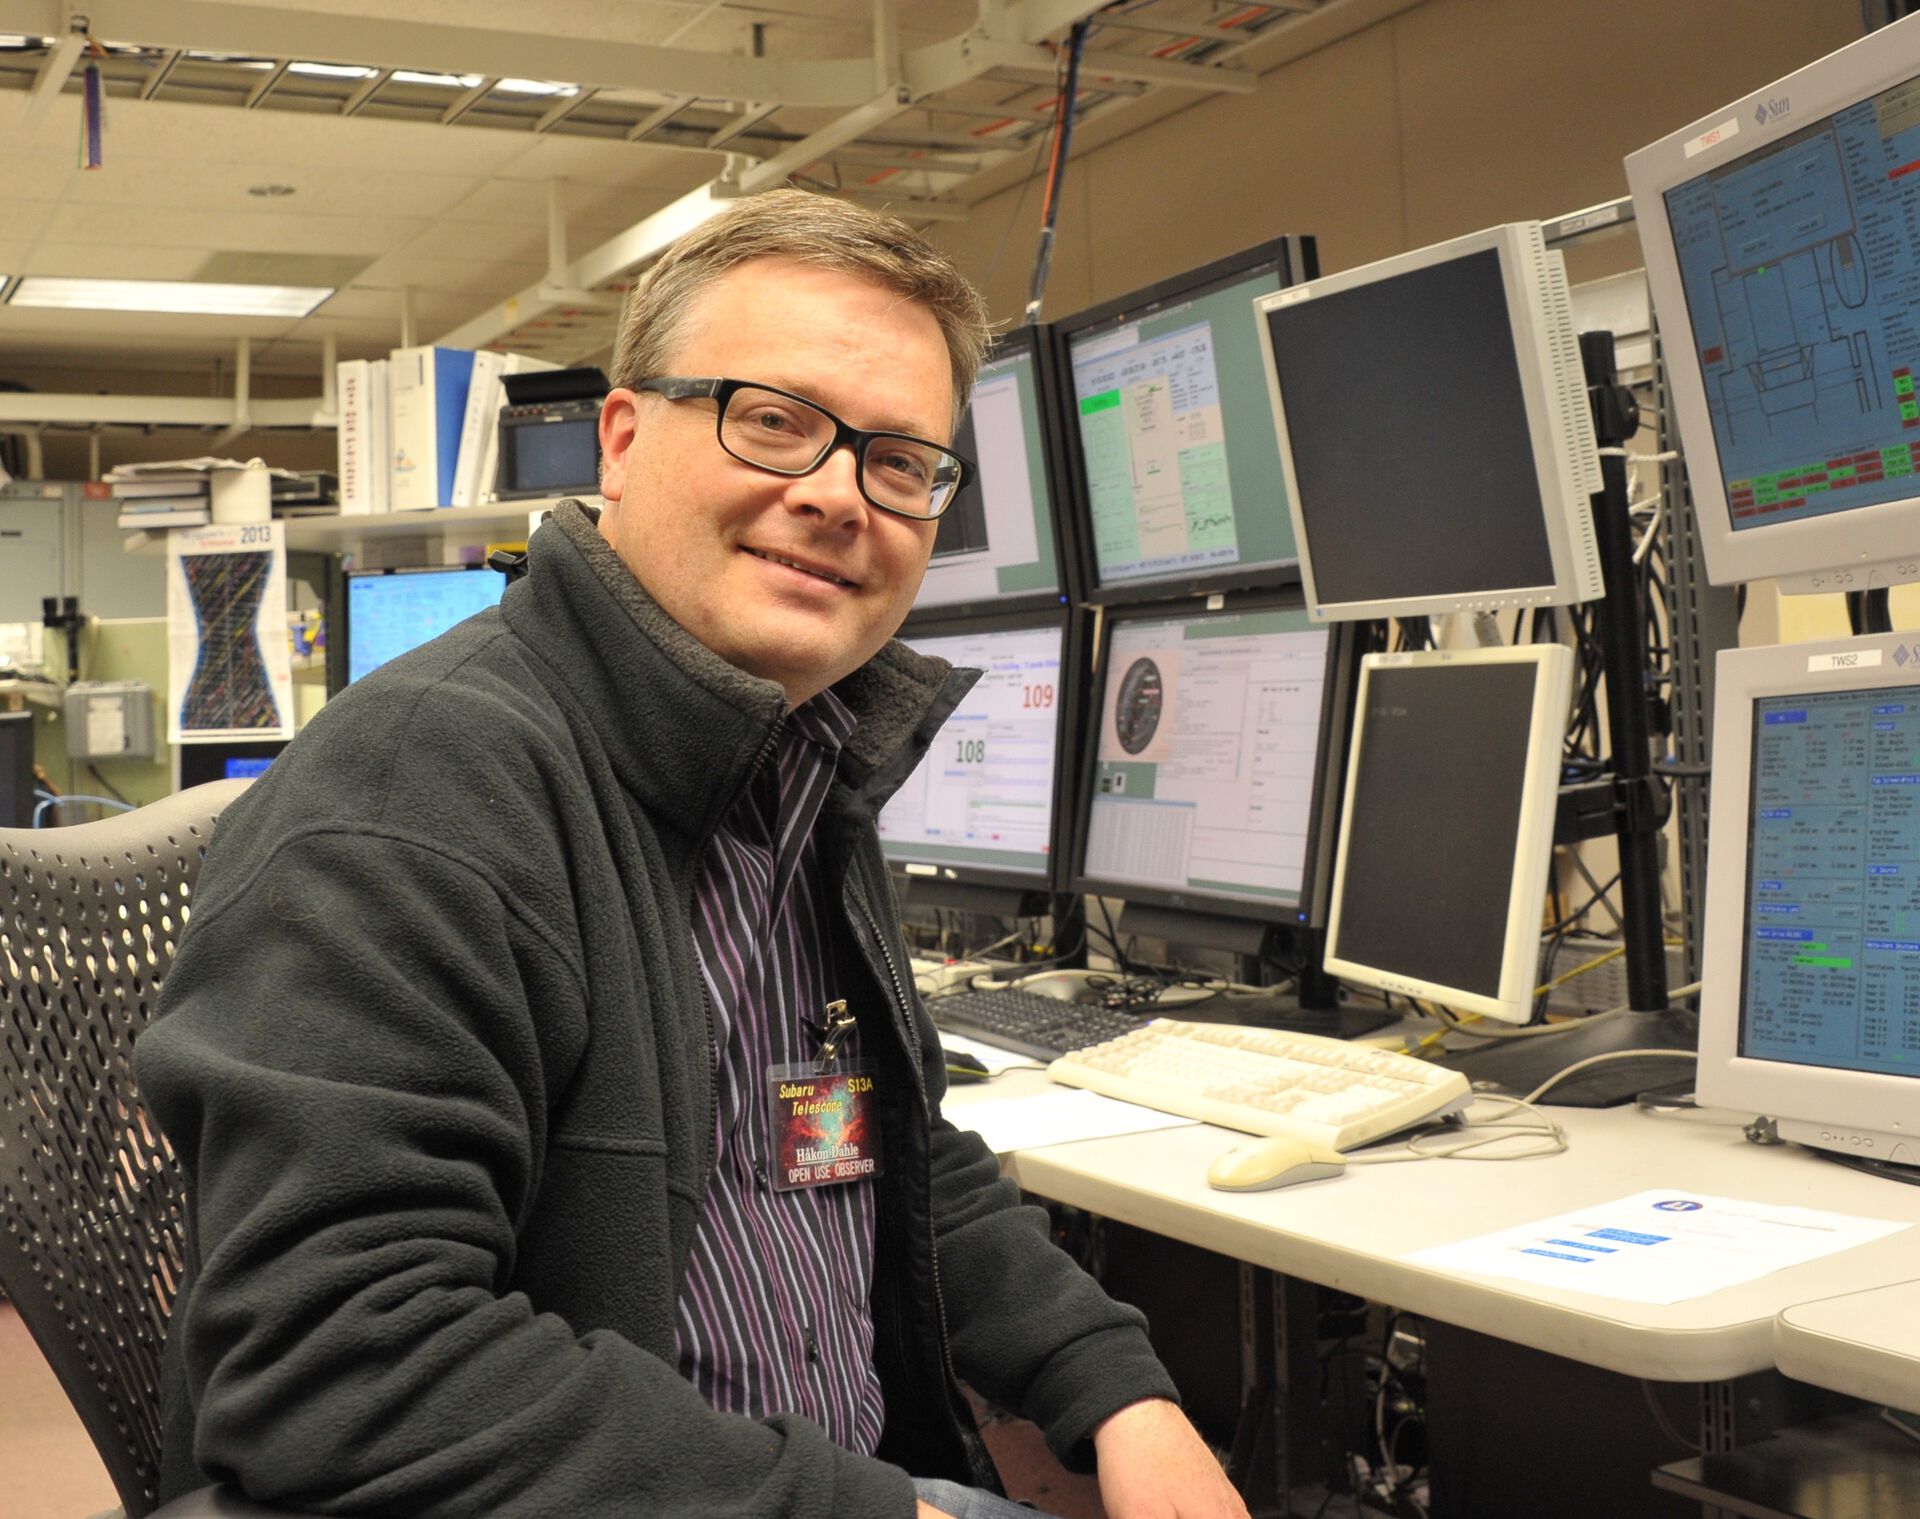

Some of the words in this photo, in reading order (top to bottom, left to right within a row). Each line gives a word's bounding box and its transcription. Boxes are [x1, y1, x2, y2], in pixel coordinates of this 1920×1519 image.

[1768, 96, 1790, 116] Sun
[240, 526, 271, 544] 2013
[1831, 654, 1858, 667] TWS2
[1023, 684, 1053, 709] 109
[956, 739, 985, 764] 108
[779, 1084, 814, 1099] Subaru
[847, 1077, 874, 1093] S13A
[792, 1100, 842, 1116] Telescope
[796, 1147, 829, 1162] Håkon
[831, 1143, 859, 1158] Dahle
[788, 1167, 811, 1183] OPEN
[815, 1164, 831, 1179] USE
[835, 1158, 875, 1176] OBSERVER
